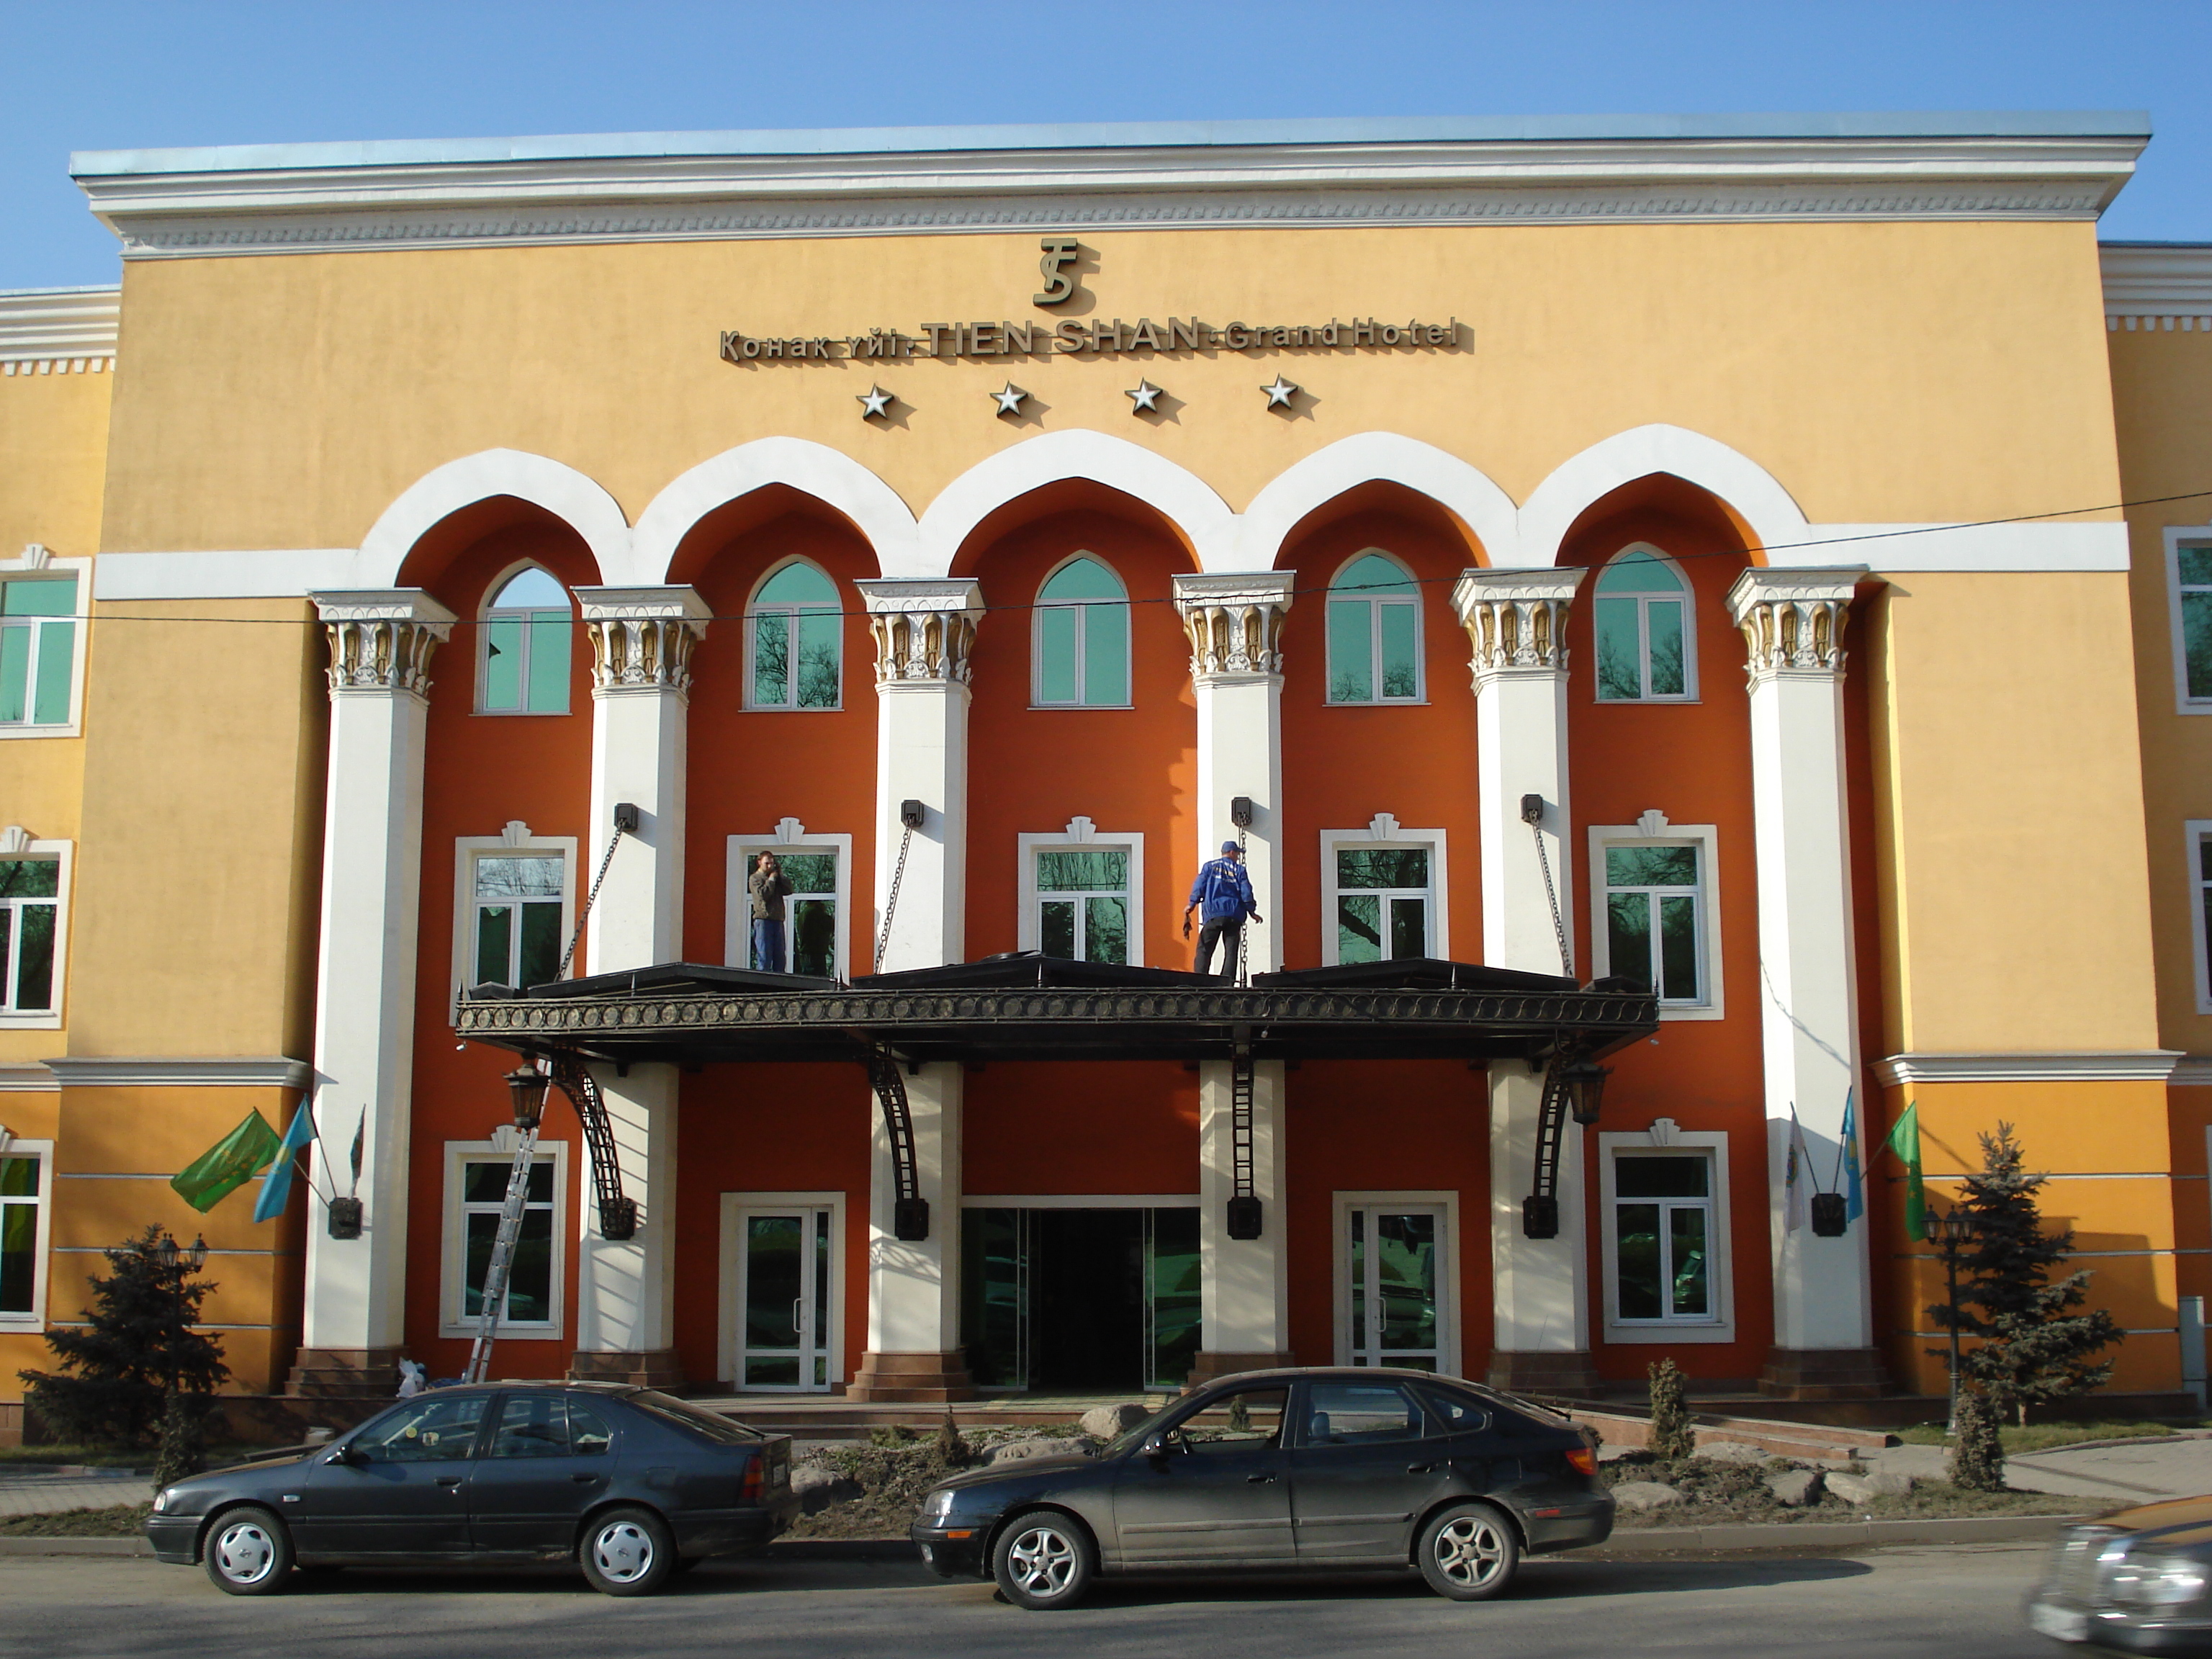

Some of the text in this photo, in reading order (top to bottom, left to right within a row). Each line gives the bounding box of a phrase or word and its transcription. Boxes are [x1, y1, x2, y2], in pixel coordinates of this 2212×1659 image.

[921, 320, 1033, 356] TIEN
[1055, 316, 1198, 352] SHAN
[1225, 317, 1337, 349] Grand
[1352, 316, 1457, 346] Hotel
